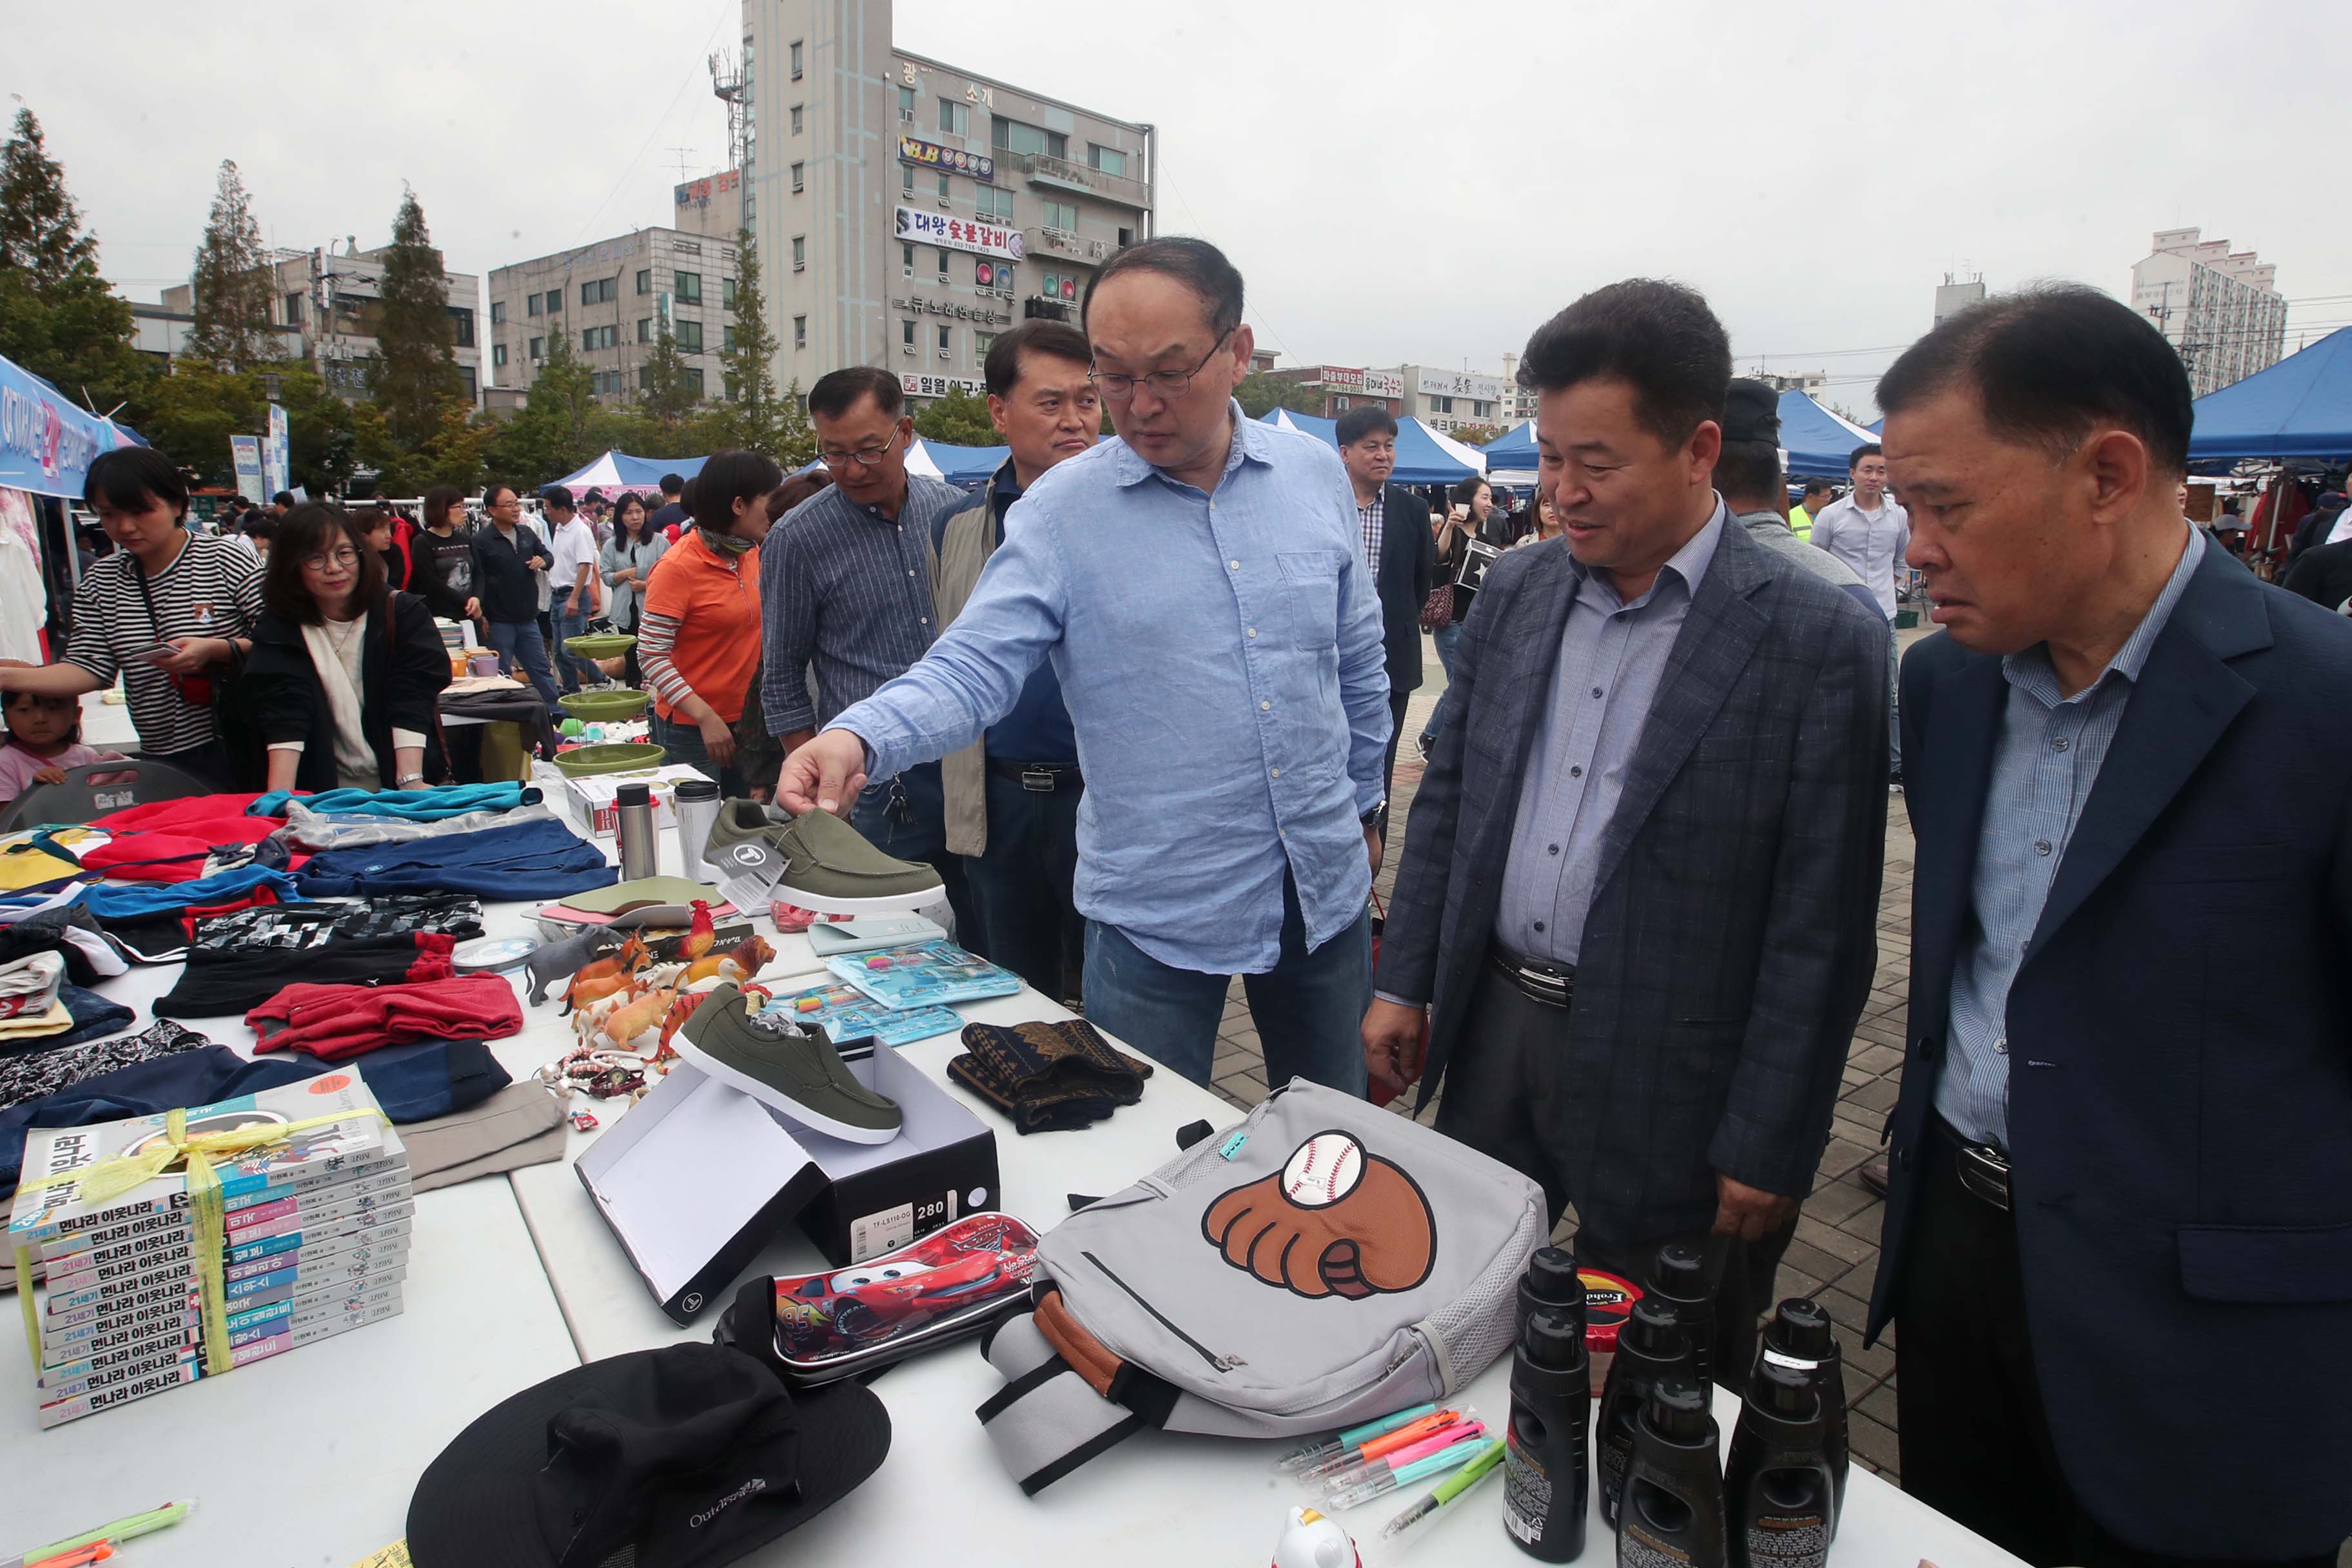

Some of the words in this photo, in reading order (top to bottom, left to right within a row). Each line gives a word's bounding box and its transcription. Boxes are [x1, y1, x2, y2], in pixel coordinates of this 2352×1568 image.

[915, 213, 946, 235] 대왕
[948, 219, 1007, 249] 숯불갈비
[921, 377, 946, 395] 일월
[59, 1213, 98, 1233] 먼나라
[101, 1201, 152, 1222] 이웃나라
[91, 1224, 129, 1244] 먼나라
[133, 1211, 182, 1233] 이웃나라
[917, 1201, 943, 1220] 280
[93, 1243, 132, 1264] 먼나라
[135, 1230, 184, 1252] 이웃나라
[229, 1212, 256, 1228] 미국
[98, 1260, 136, 1280] 먼나라
[139, 1246, 189, 1268] 이웃나라
[100, 1278, 139, 1298] 먼나라
[141, 1264, 191, 1286] 이웃나라
[235, 1245, 263, 1261] 일본
[96, 1296, 134, 1317] 먼나라
[137, 1282, 186, 1304] 이웃나라
[230, 1254, 283, 1279] 이탈리아
[96, 1313, 133, 1333] 먼나라
[137, 1298, 186, 1321] 이웃나라
[230, 1276, 269, 1295] 스위스
[781, 1304, 814, 1335] 95
[91, 1331, 129, 1351] 먼나라
[132, 1317, 181, 1339] 이웃나라
[92, 1349, 130, 1370] 먼나라
[132, 1334, 182, 1357] 이웃나라
[87, 1369, 126, 1389] 먼나라
[128, 1353, 177, 1376] 이웃나라
[230, 1328, 260, 1346] 랑스
[90, 1387, 129, 1409] 먼나라
[131, 1371, 181, 1395] 이웃나라
